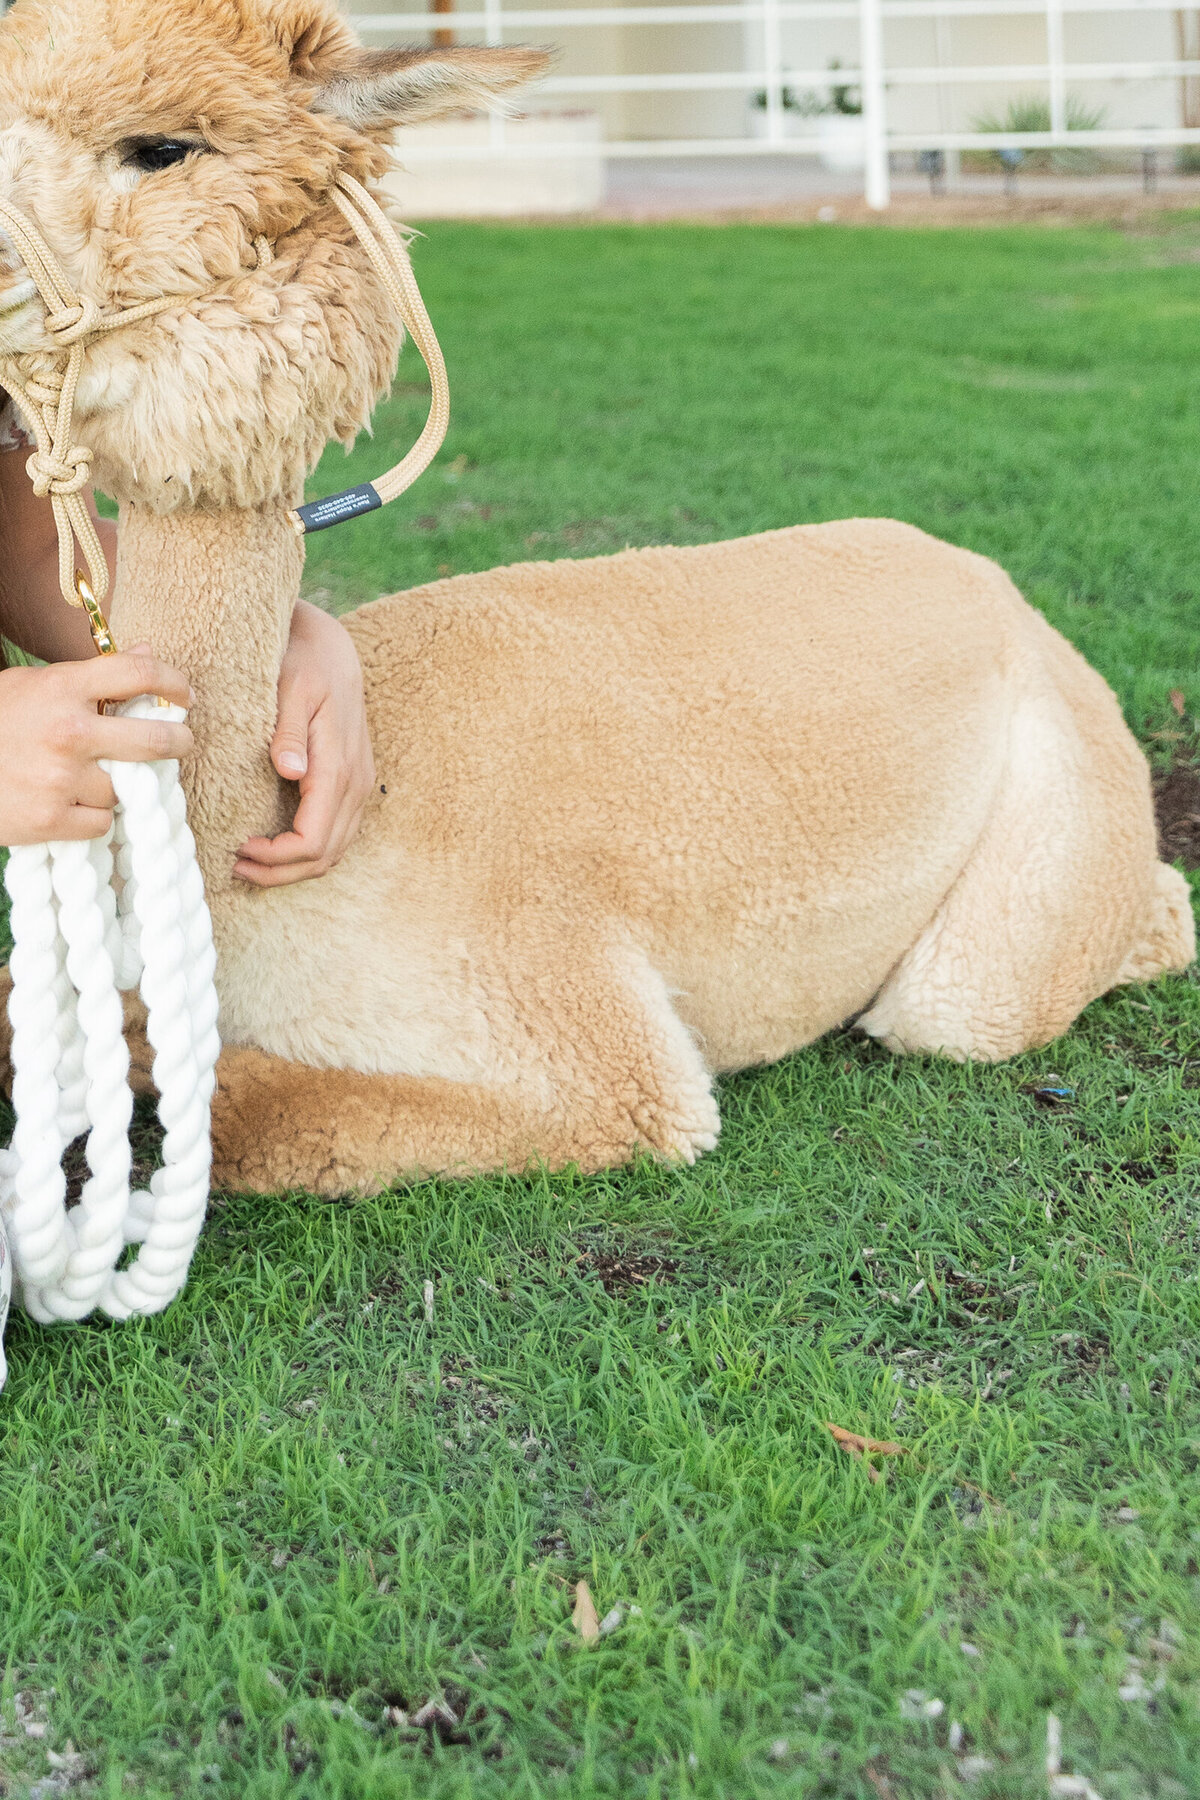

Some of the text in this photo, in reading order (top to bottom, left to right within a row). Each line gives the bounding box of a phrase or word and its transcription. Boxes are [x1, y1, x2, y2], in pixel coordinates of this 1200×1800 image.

[314, 499, 370, 522] Rae's Rope Halters
